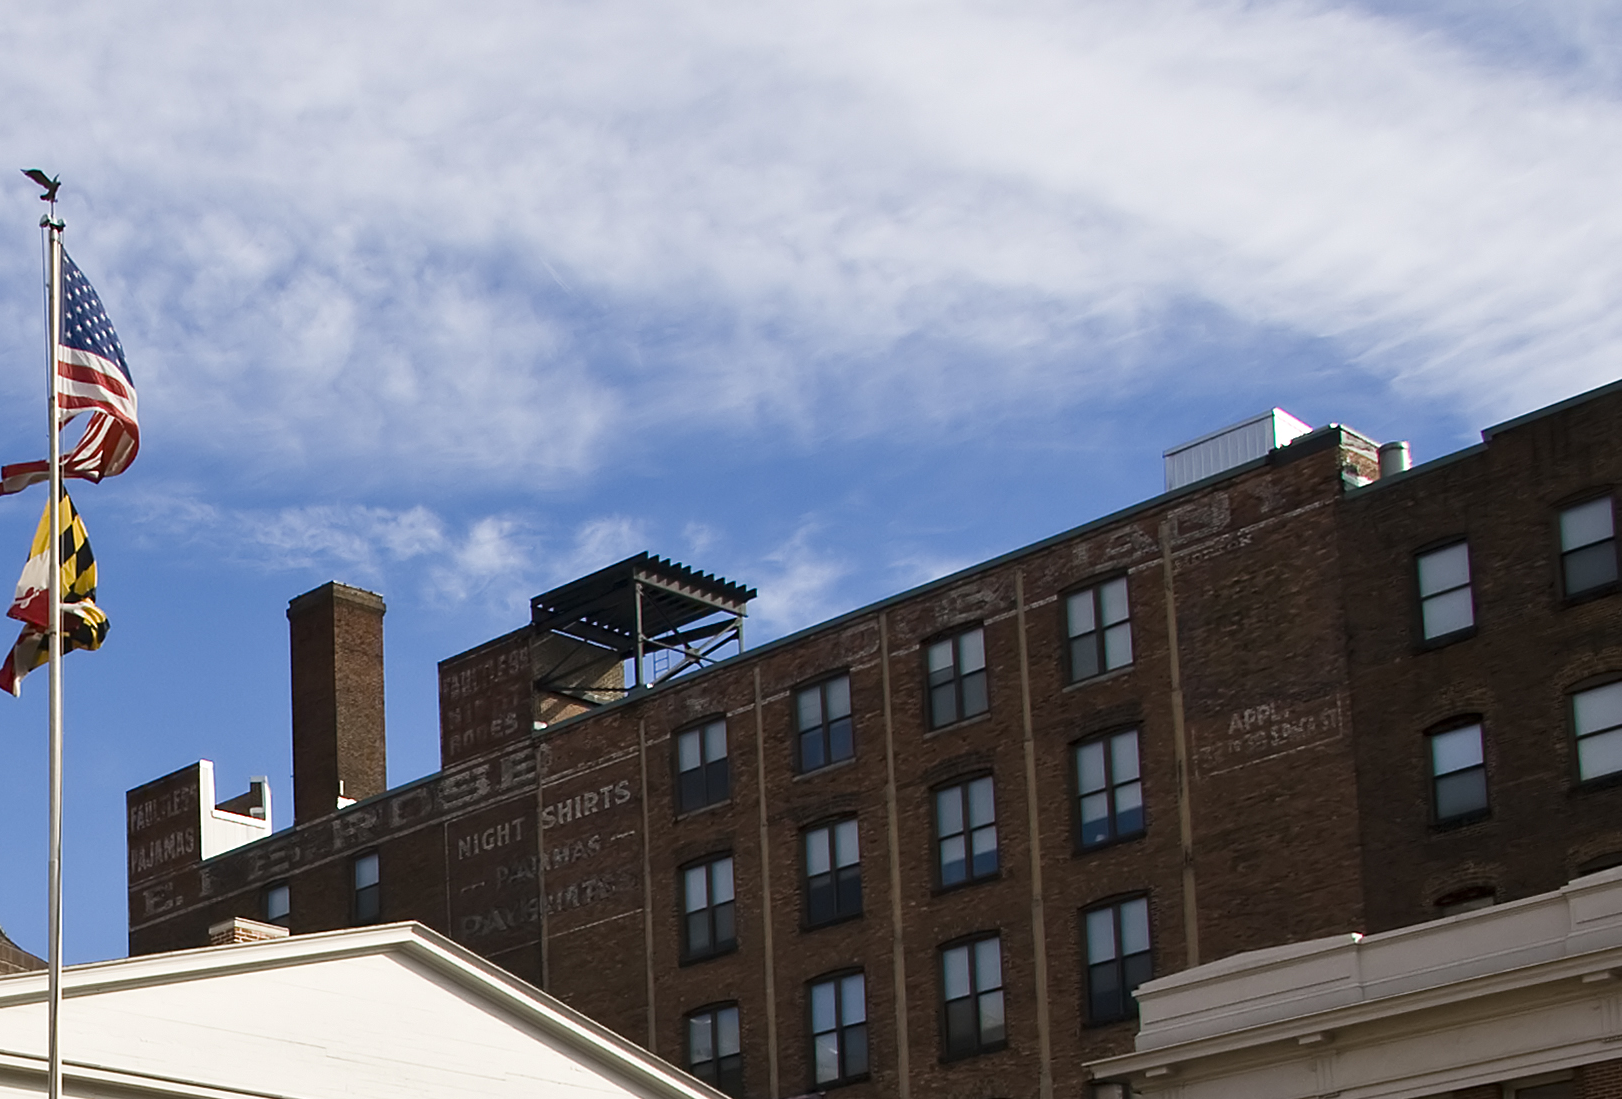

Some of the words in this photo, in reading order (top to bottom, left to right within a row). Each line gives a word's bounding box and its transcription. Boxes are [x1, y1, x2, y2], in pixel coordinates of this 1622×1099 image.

[130, 827, 195, 874] PAJAMAS
[458, 817, 526, 860] NIGHT
[541, 779, 631, 830] SHIRTS
